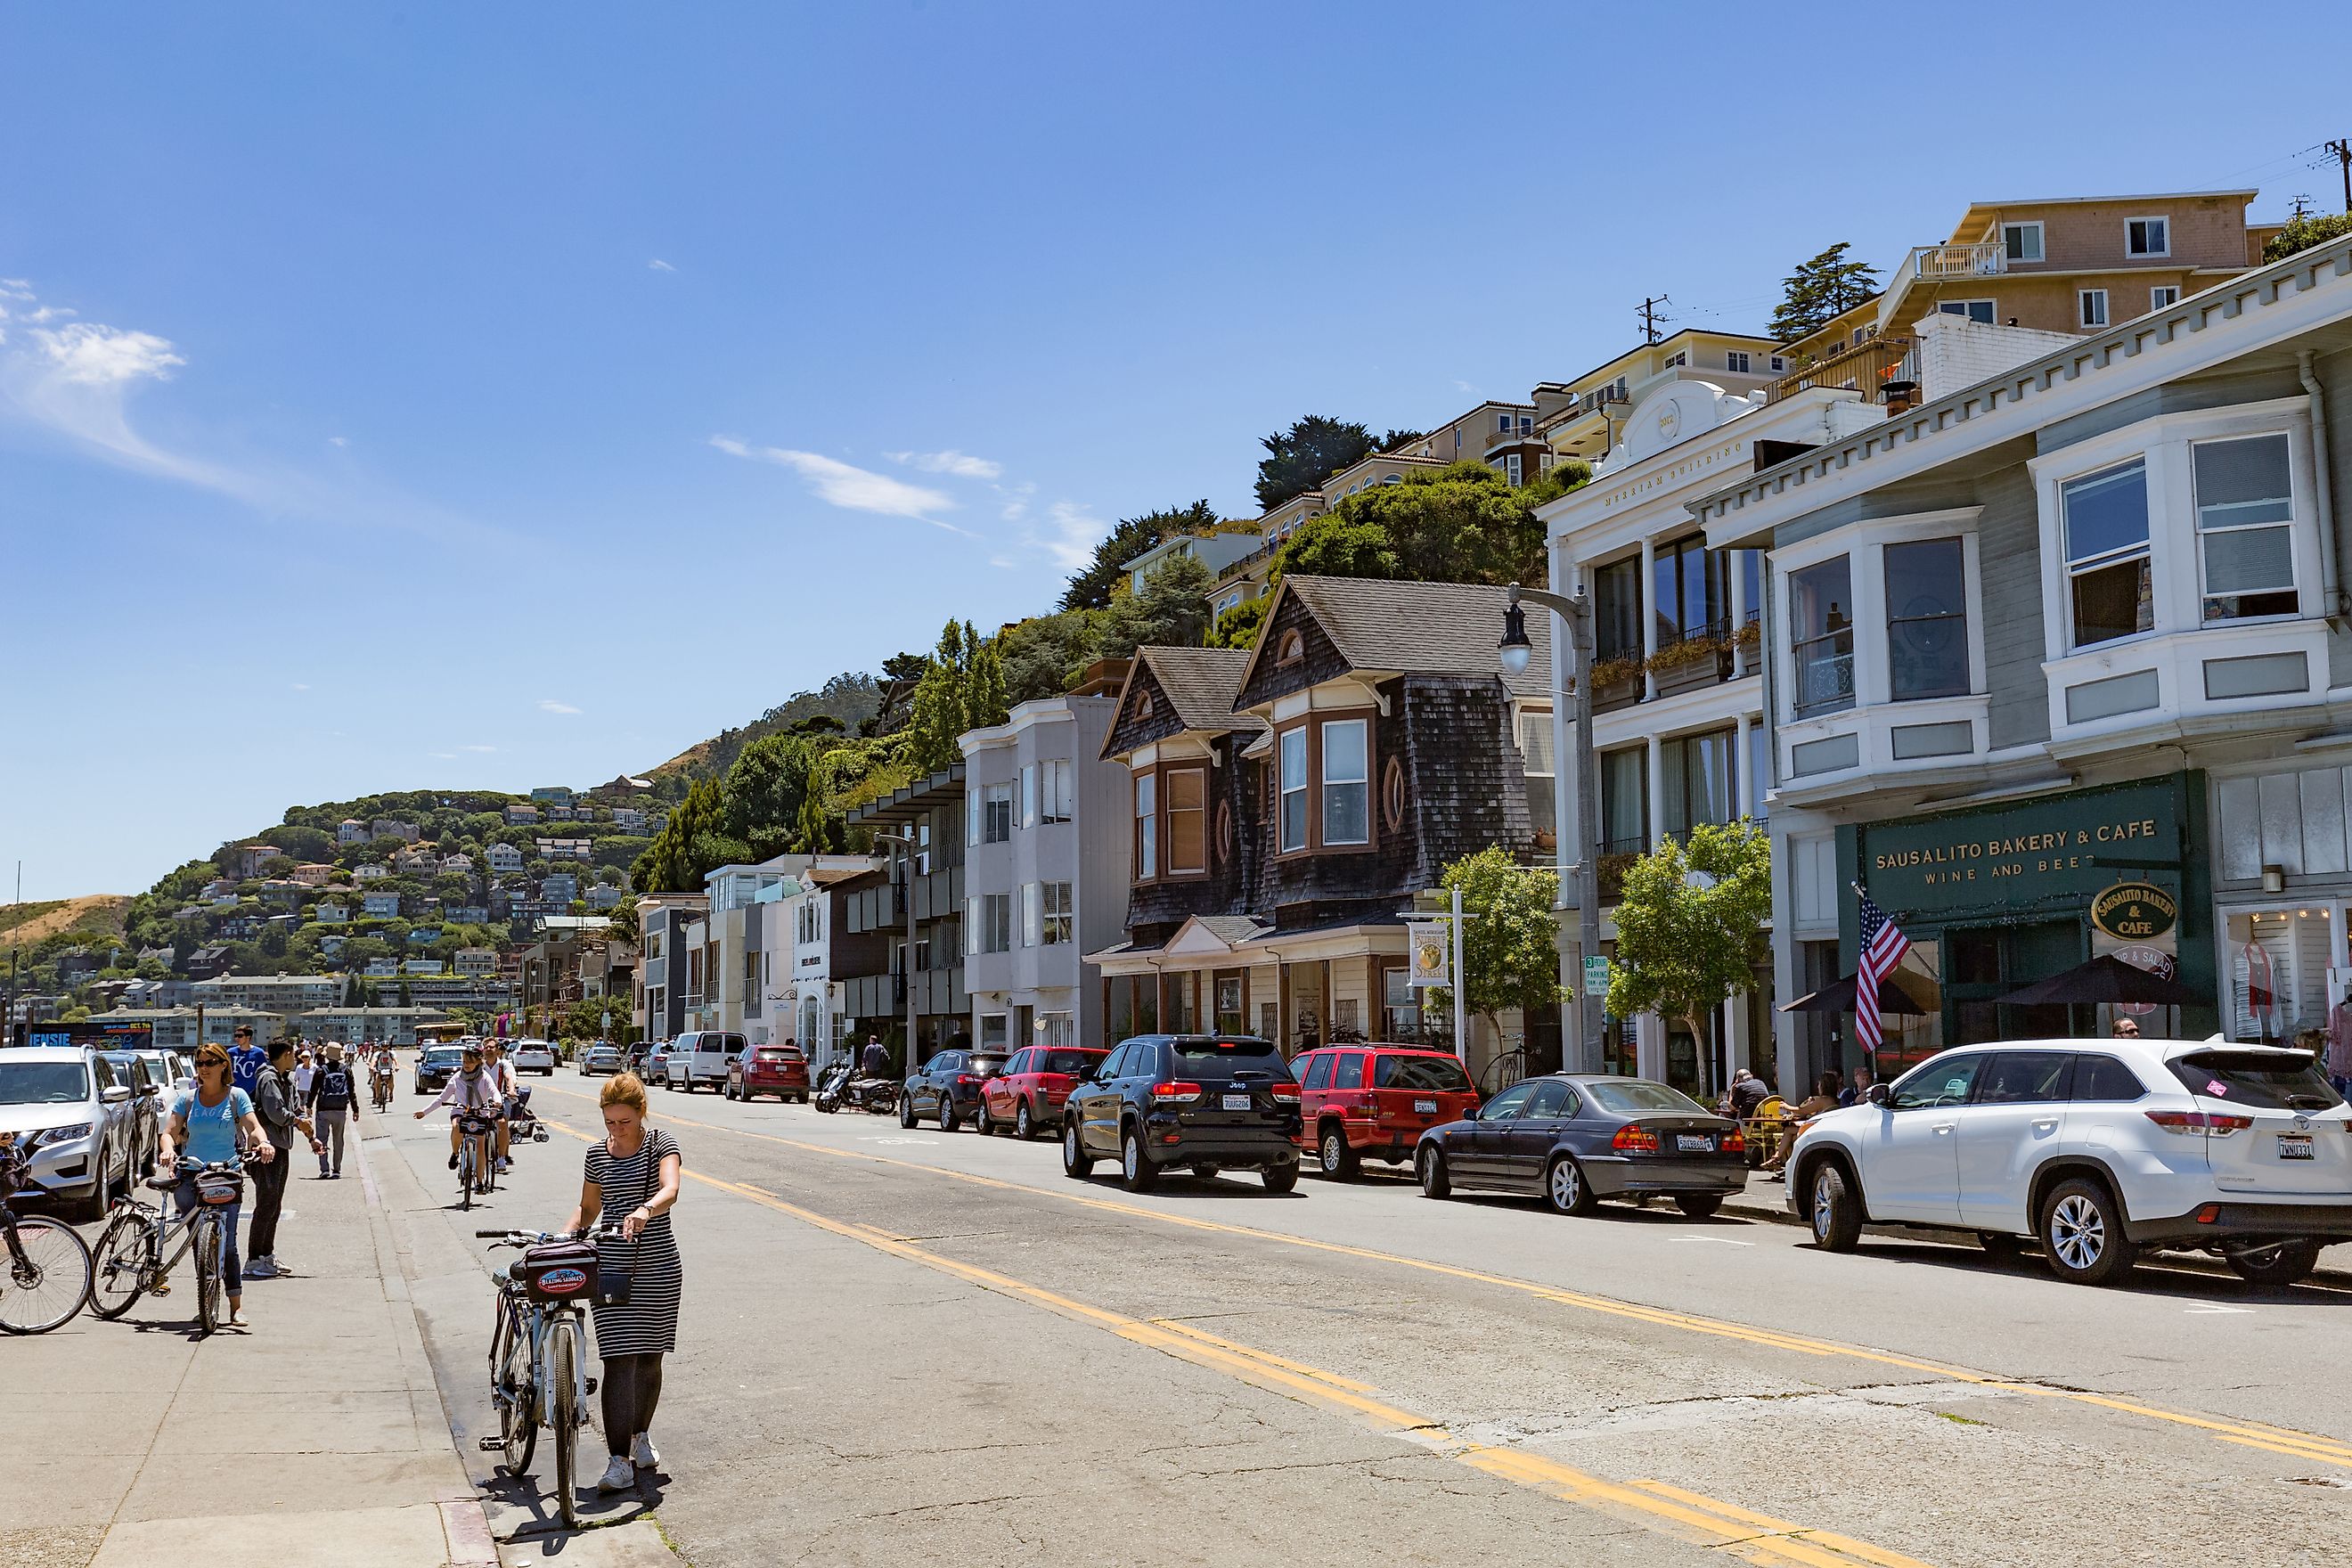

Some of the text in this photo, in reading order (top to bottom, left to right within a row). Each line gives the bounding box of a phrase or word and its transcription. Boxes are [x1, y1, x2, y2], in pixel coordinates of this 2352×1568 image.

[1605, 443, 1741, 507] MERRIAM BUILDING
[1875, 819, 2156, 870] SAUSALITO BAKERY & CAFE
[1924, 854, 2095, 885] WINE AND BEE
[2097, 889, 2175, 918] SAUSALITO BAKERY
[2128, 905, 2141, 918] &
[2118, 921, 2153, 935] CAFE
[1587, 958, 1607, 968] 3 HOUR
[2132, 951, 2138, 961] &
[2143, 951, 2170, 973] SALAD
[1415, 964, 1447, 978] STREET
[233, 1055, 256, 1079] KC
[1502, 1057, 1517, 1069] OPEN
[1229, 1082, 1246, 1090] Jeep
[2280, 1145, 2312, 1156] 7WNU331
